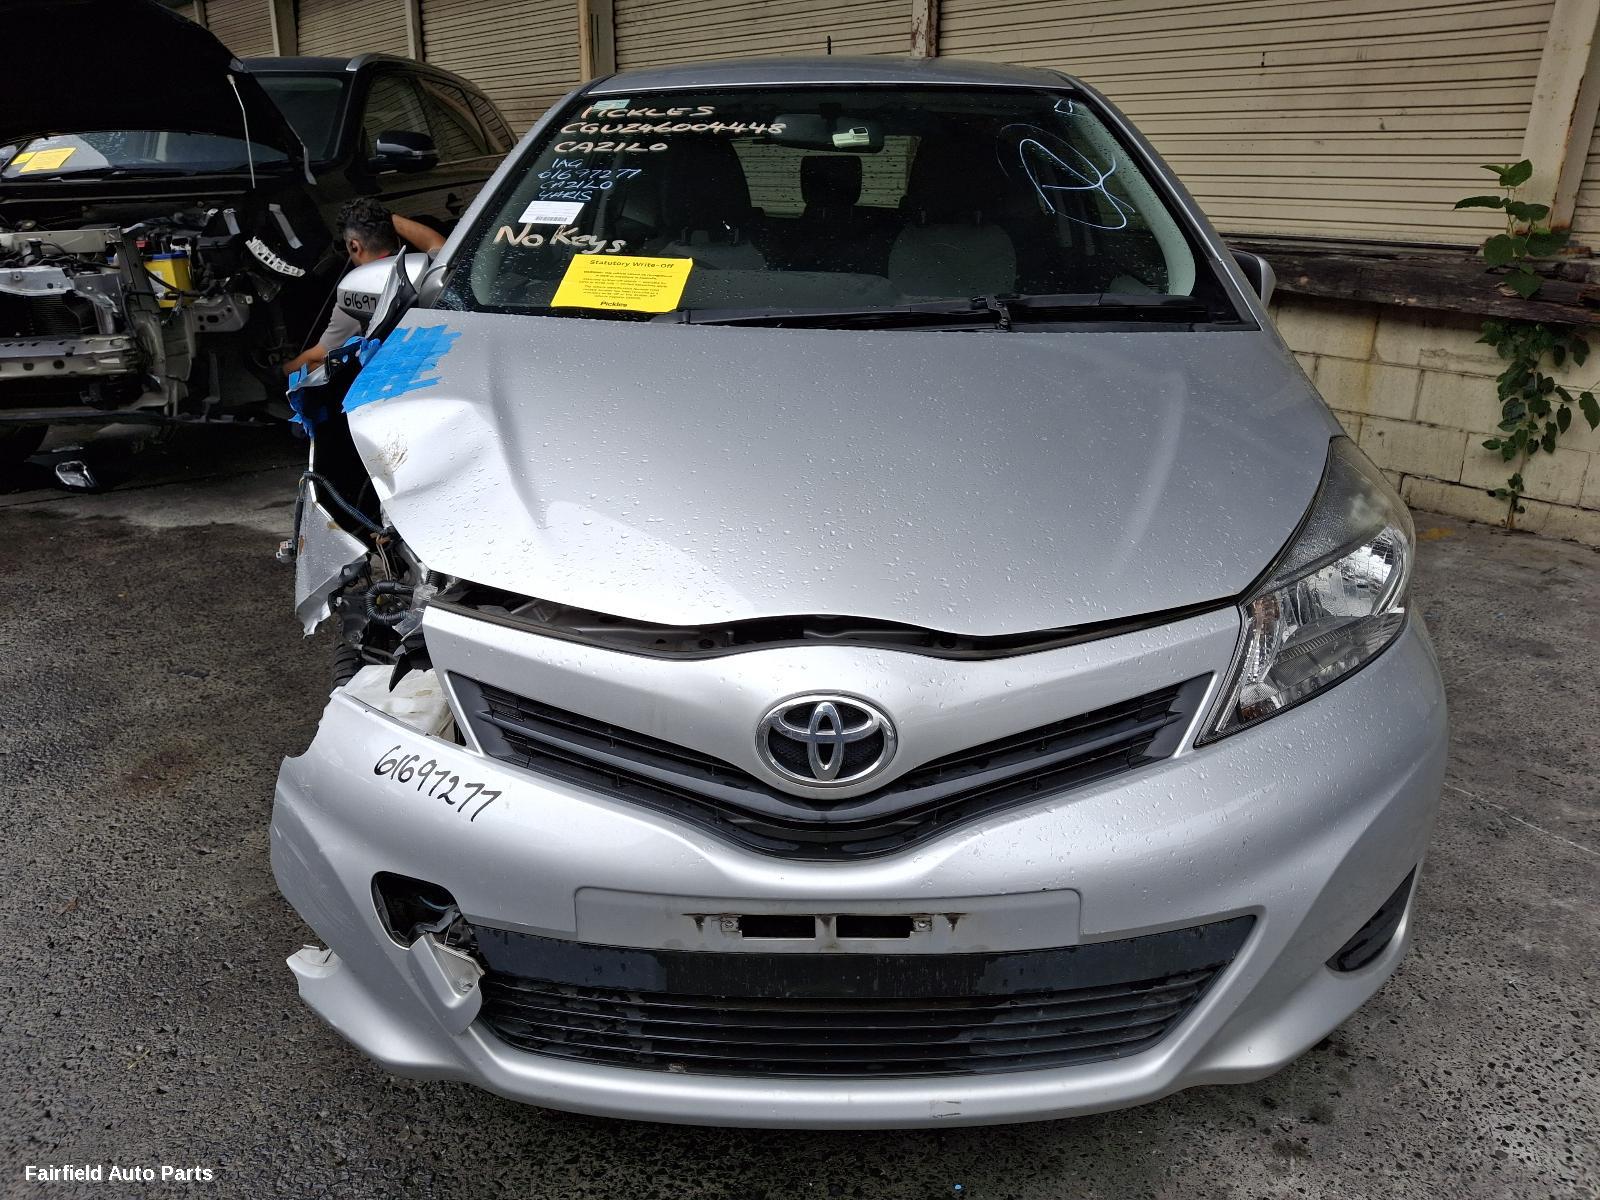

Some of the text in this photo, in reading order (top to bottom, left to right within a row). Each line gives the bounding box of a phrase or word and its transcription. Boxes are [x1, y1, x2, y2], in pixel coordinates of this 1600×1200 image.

[492, 222, 627, 255] No Keys
[589, 258, 675, 270] Statutory Write-Off
[373, 744, 503, 823] 61697277
